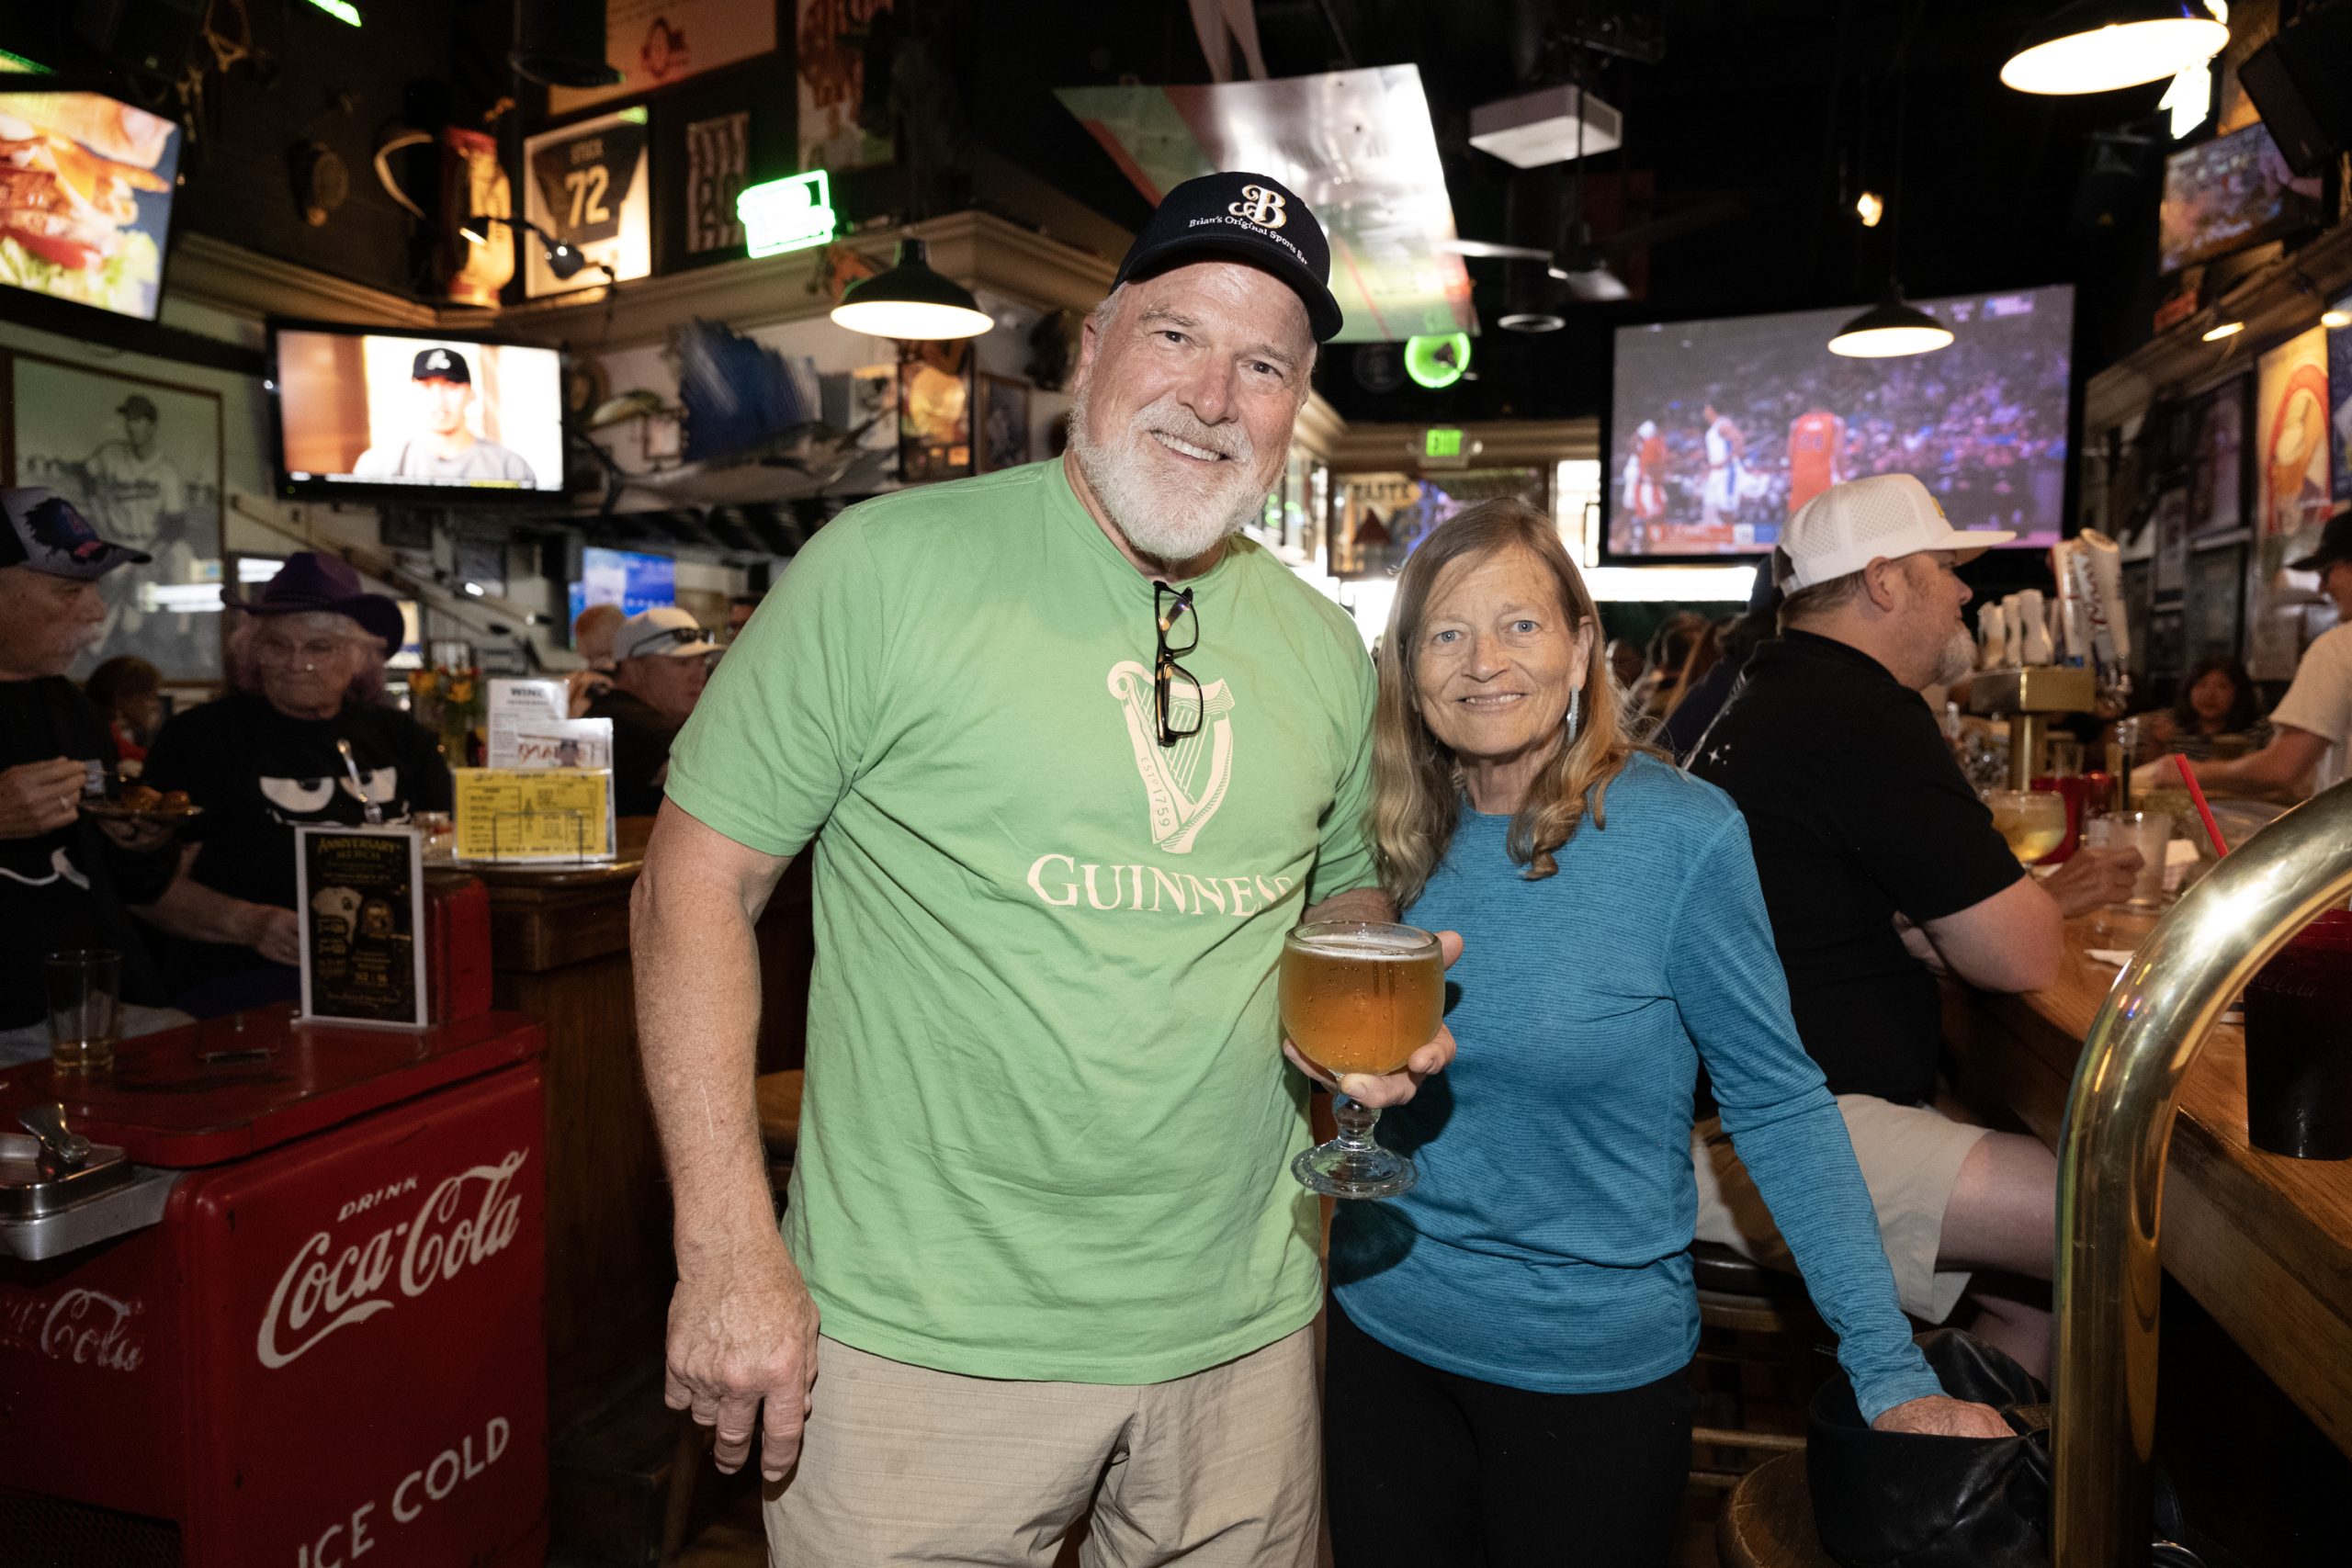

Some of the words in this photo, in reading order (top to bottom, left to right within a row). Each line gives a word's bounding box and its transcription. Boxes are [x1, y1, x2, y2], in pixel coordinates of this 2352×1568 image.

[564, 164, 610, 230] 72
[1188, 215, 1223, 229] Brian's
[1225, 215, 1268, 236] Original
[1270, 230, 1296, 254] Sports
[1296, 249, 1308, 265] Bar
[1153, 788, 1170, 828] 1759
[336, 1175, 419, 1223] DRINK
[256, 1146, 530, 1370] Coca-Cola
[297, 1500, 376, 1568] ICE
[390, 1416, 511, 1524] COLD
